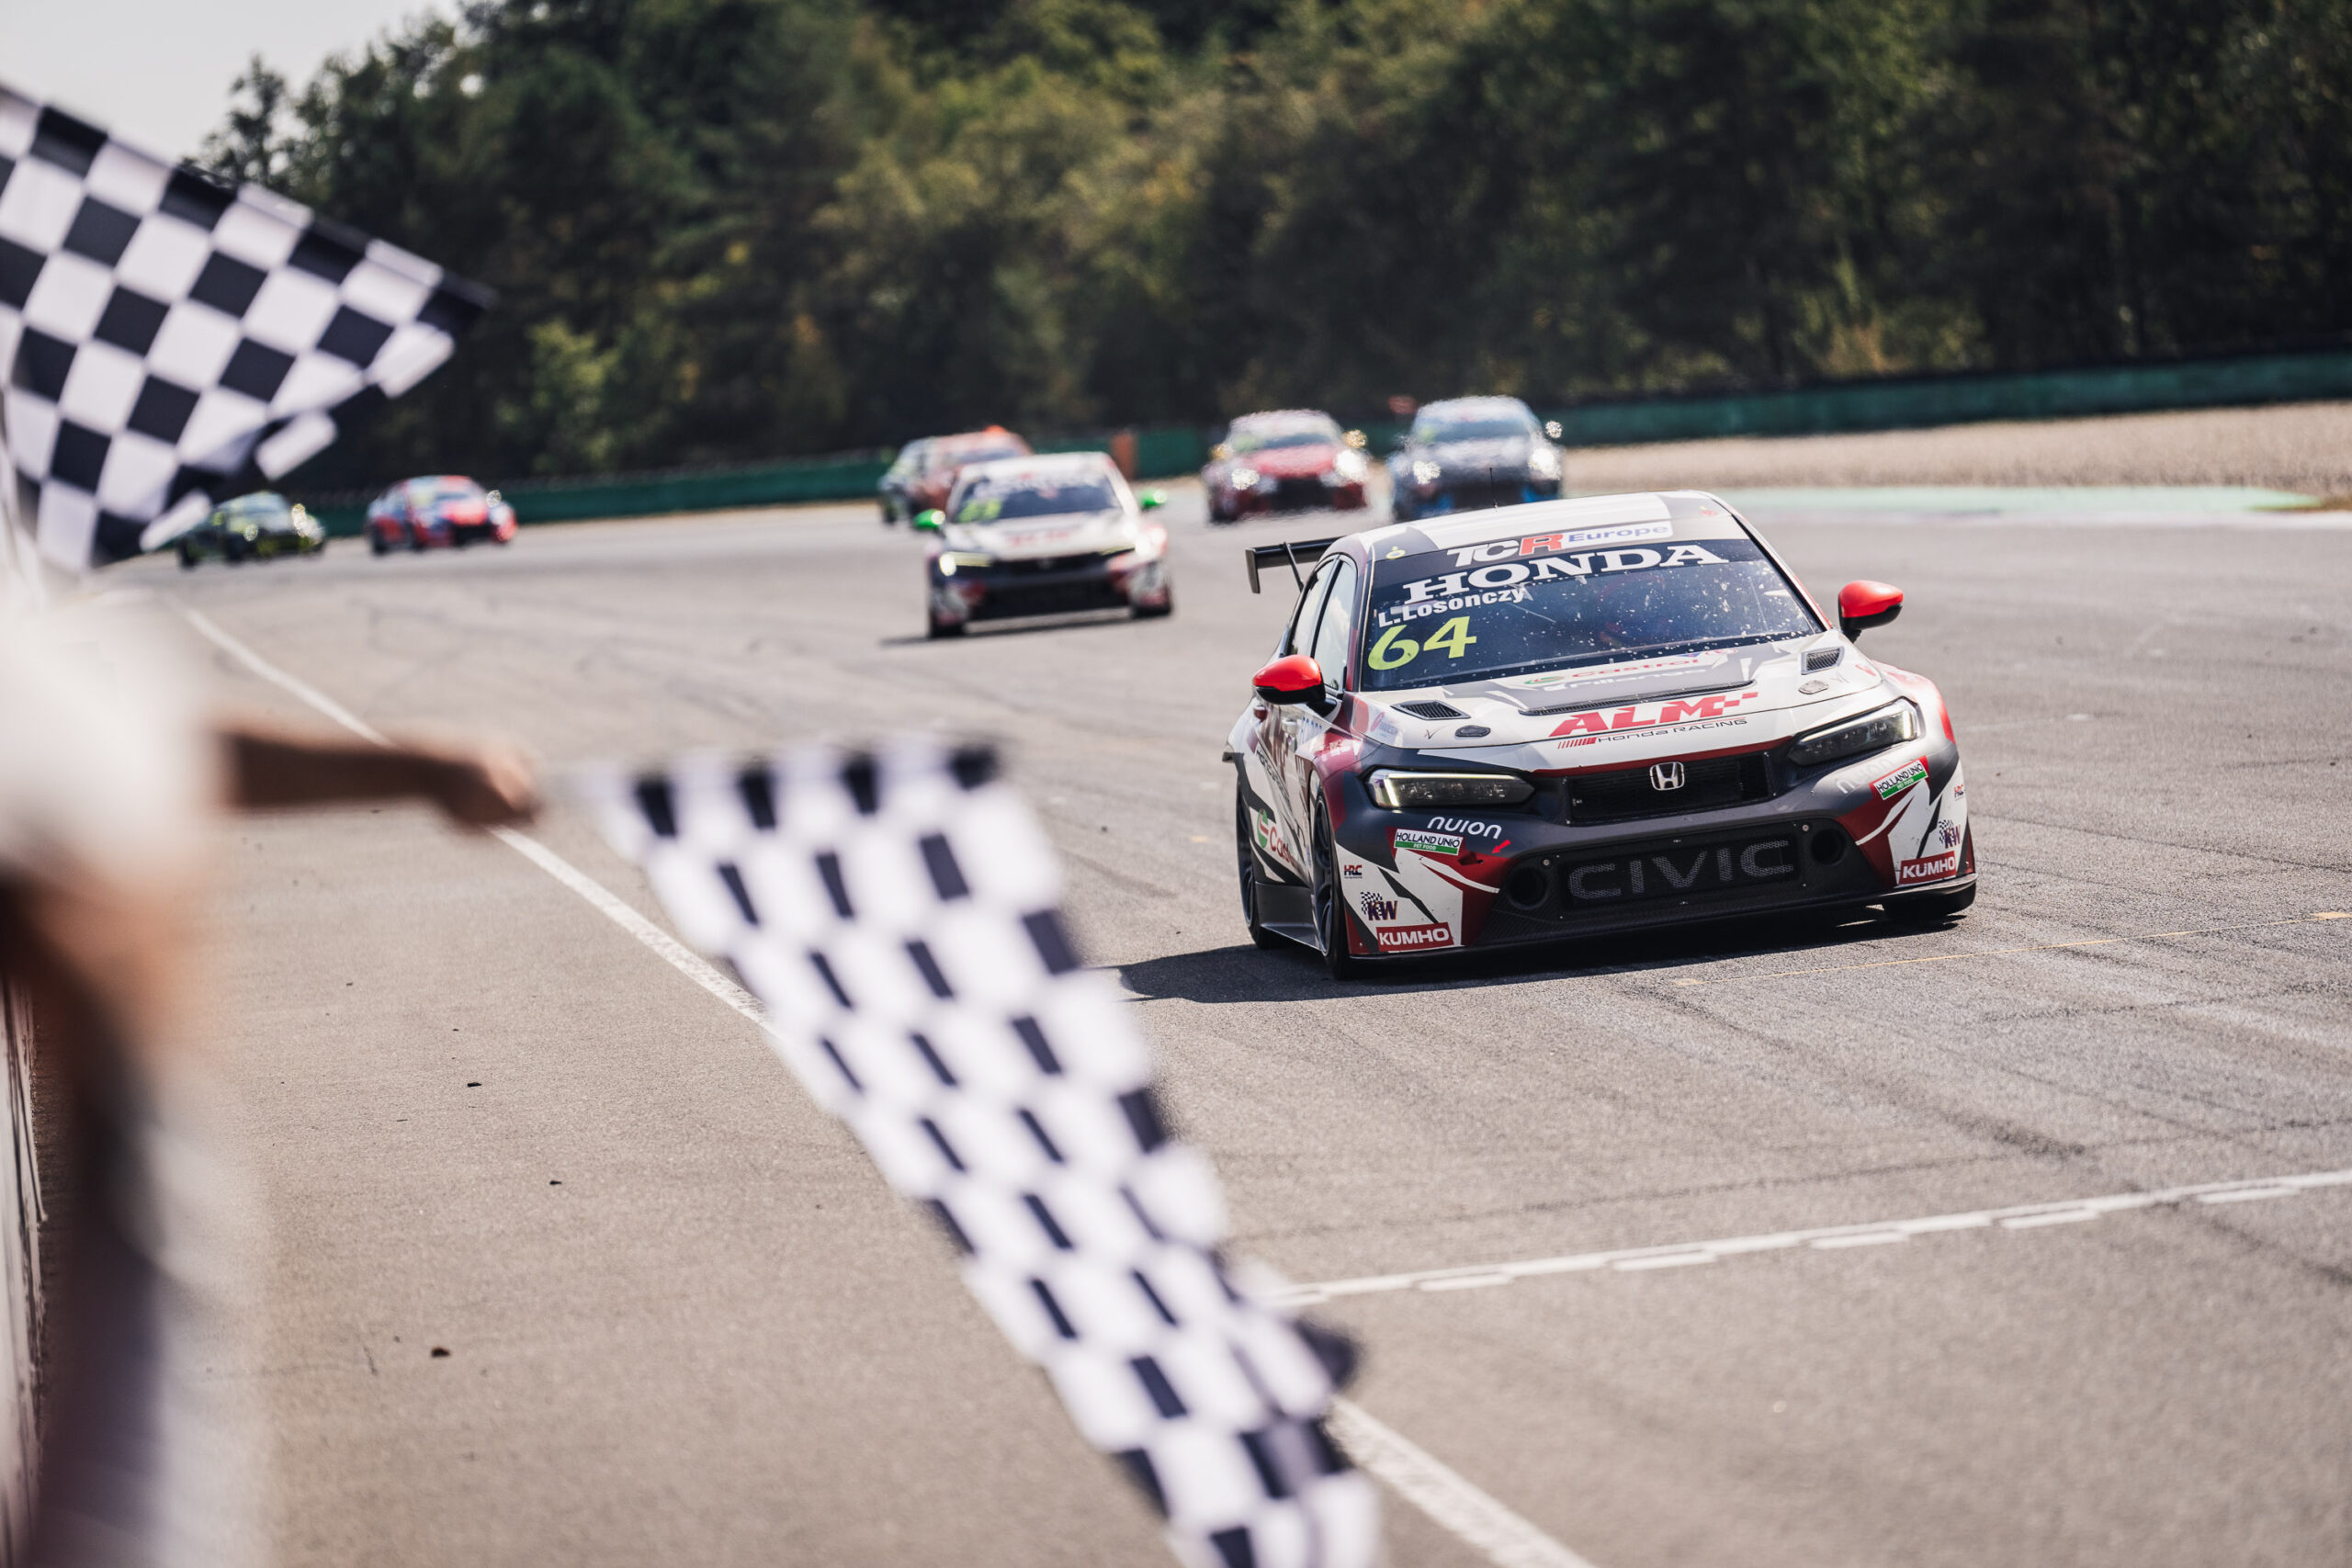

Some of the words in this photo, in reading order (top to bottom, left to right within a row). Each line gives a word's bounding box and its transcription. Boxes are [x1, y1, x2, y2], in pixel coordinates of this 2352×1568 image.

[1446, 534, 1564, 567] TCR
[1568, 523, 1670, 543] Europe
[1403, 544, 1729, 604] HONDA
[1378, 587, 1525, 627] L.Losonczy
[1368, 615, 1477, 671] 64
[1549, 694, 1732, 737] ALM
[1598, 728, 1668, 743] Honda
[1673, 720, 1748, 733] RACING
[1876, 771, 1910, 793] HOLLAND
[1396, 832, 1437, 844] HOLLAND
[1427, 816, 1502, 840] nuion
[1344, 864, 1363, 875] HRC
[1568, 840, 1793, 899] CIVIC
[1903, 856, 1955, 879] KUMHO
[1367, 900, 1397, 920] KW
[1379, 928, 1450, 946] KUMHO
